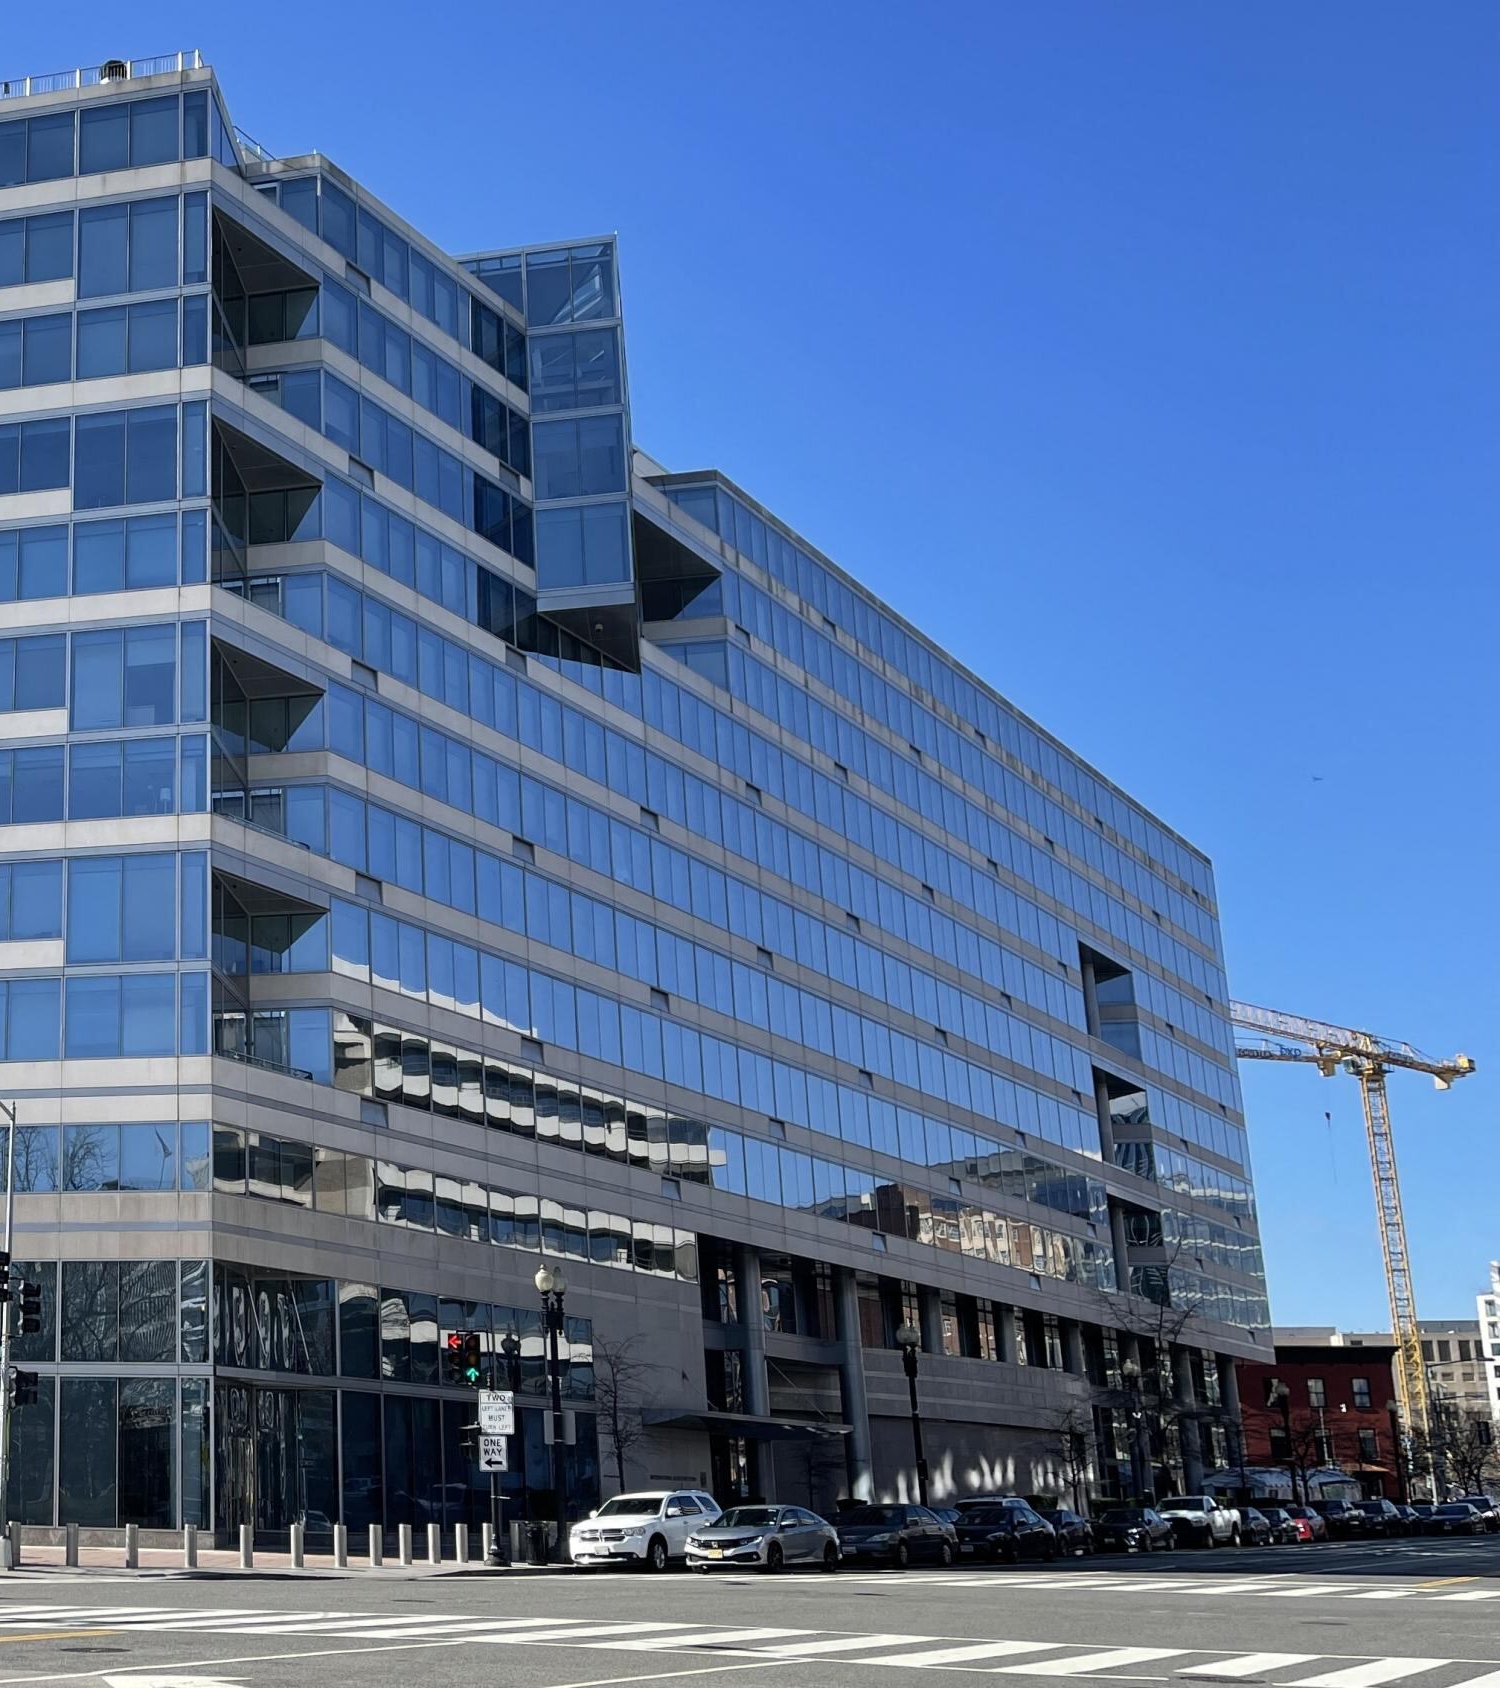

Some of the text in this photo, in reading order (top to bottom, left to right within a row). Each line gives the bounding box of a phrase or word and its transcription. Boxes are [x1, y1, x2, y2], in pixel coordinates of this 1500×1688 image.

[486, 1394, 506, 1402] TWO
[488, 1414, 506, 1422] MUST
[483, 1438, 502, 1448] ONE
[483, 1448, 503, 1456] WAY
